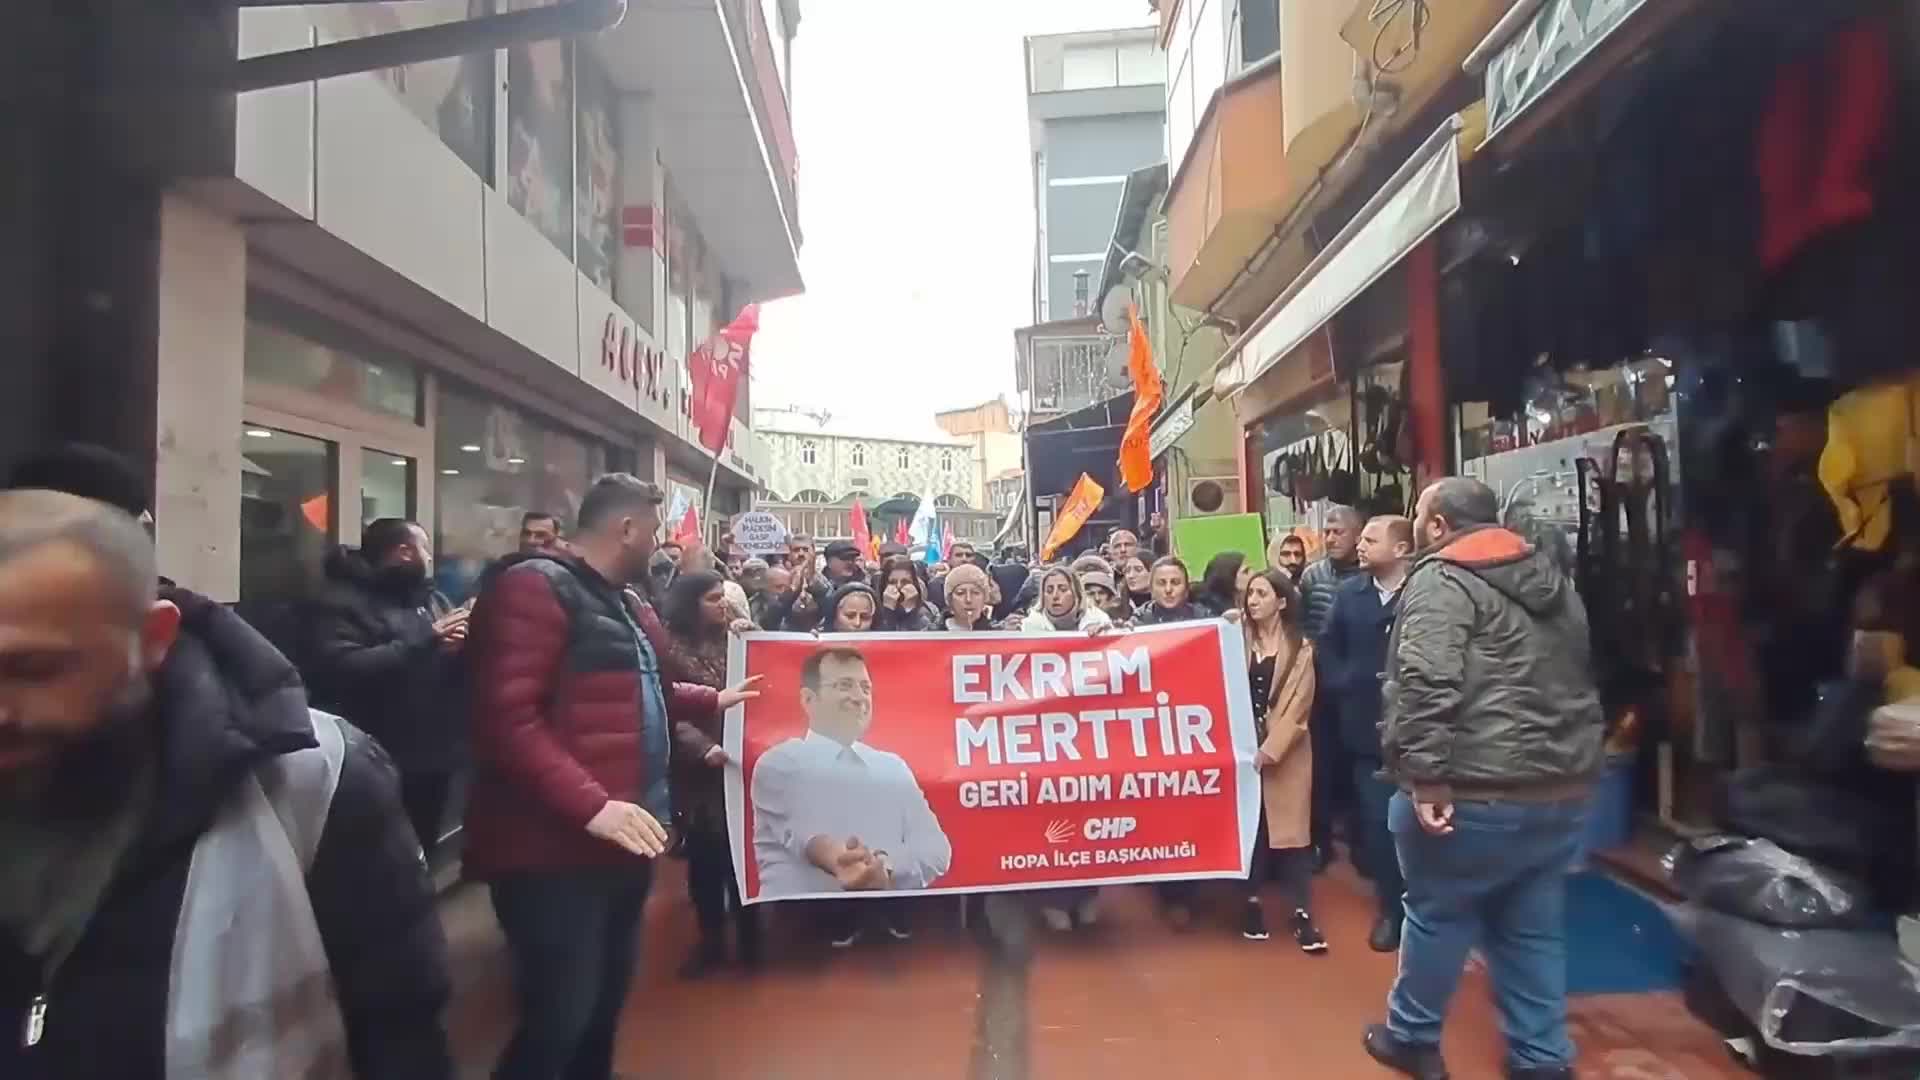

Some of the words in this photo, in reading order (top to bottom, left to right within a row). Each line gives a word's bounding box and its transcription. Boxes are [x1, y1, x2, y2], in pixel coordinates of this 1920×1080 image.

[952, 646, 1152, 704] EKREM
[954, 691, 1217, 766] MERTTİR
[959, 771, 1029, 808] GERİ
[1036, 773, 1111, 804] ADIM
[1119, 768, 1221, 801] ATMAZ
[1083, 816, 1136, 841] CHP
[1001, 853, 1049, 870] HOPA
[1053, 849, 1091, 868] İLÇE
[1095, 841, 1196, 865] BAŞKANLIĞI
